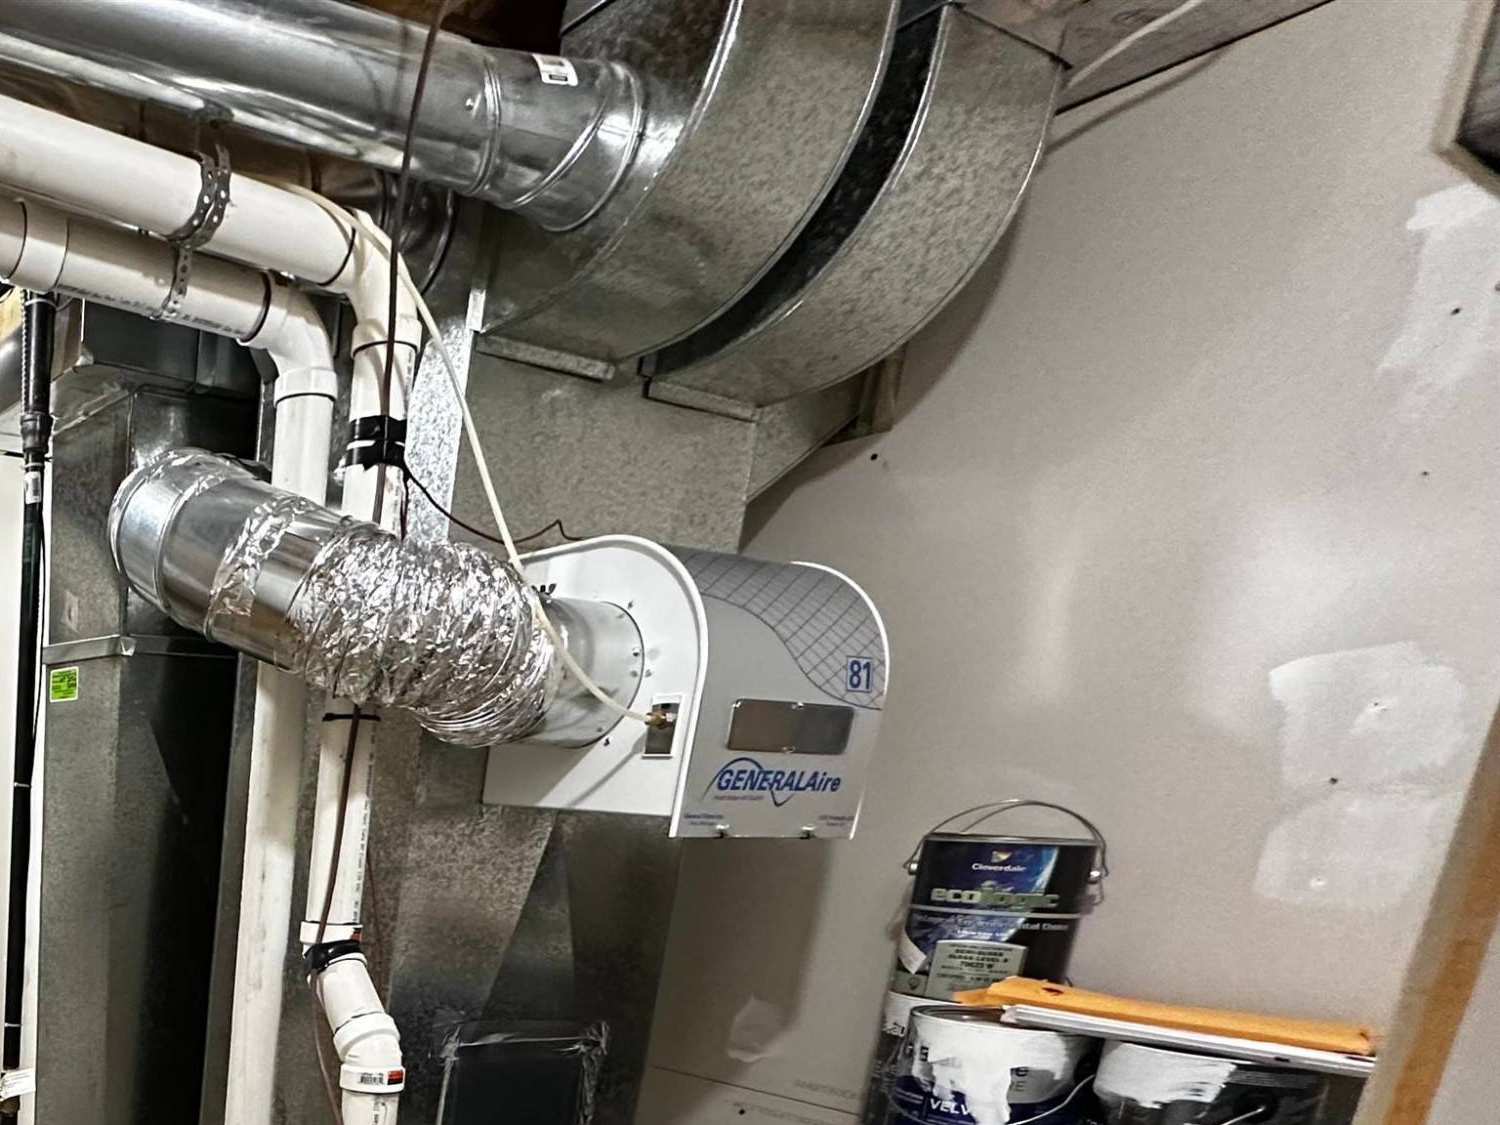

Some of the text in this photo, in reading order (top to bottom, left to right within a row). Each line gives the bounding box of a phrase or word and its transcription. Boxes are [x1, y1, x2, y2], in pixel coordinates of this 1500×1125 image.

[849, 660, 872, 690] 81
[716, 769, 842, 793] GENERALAire
[930, 1098, 971, 1116] VELV
